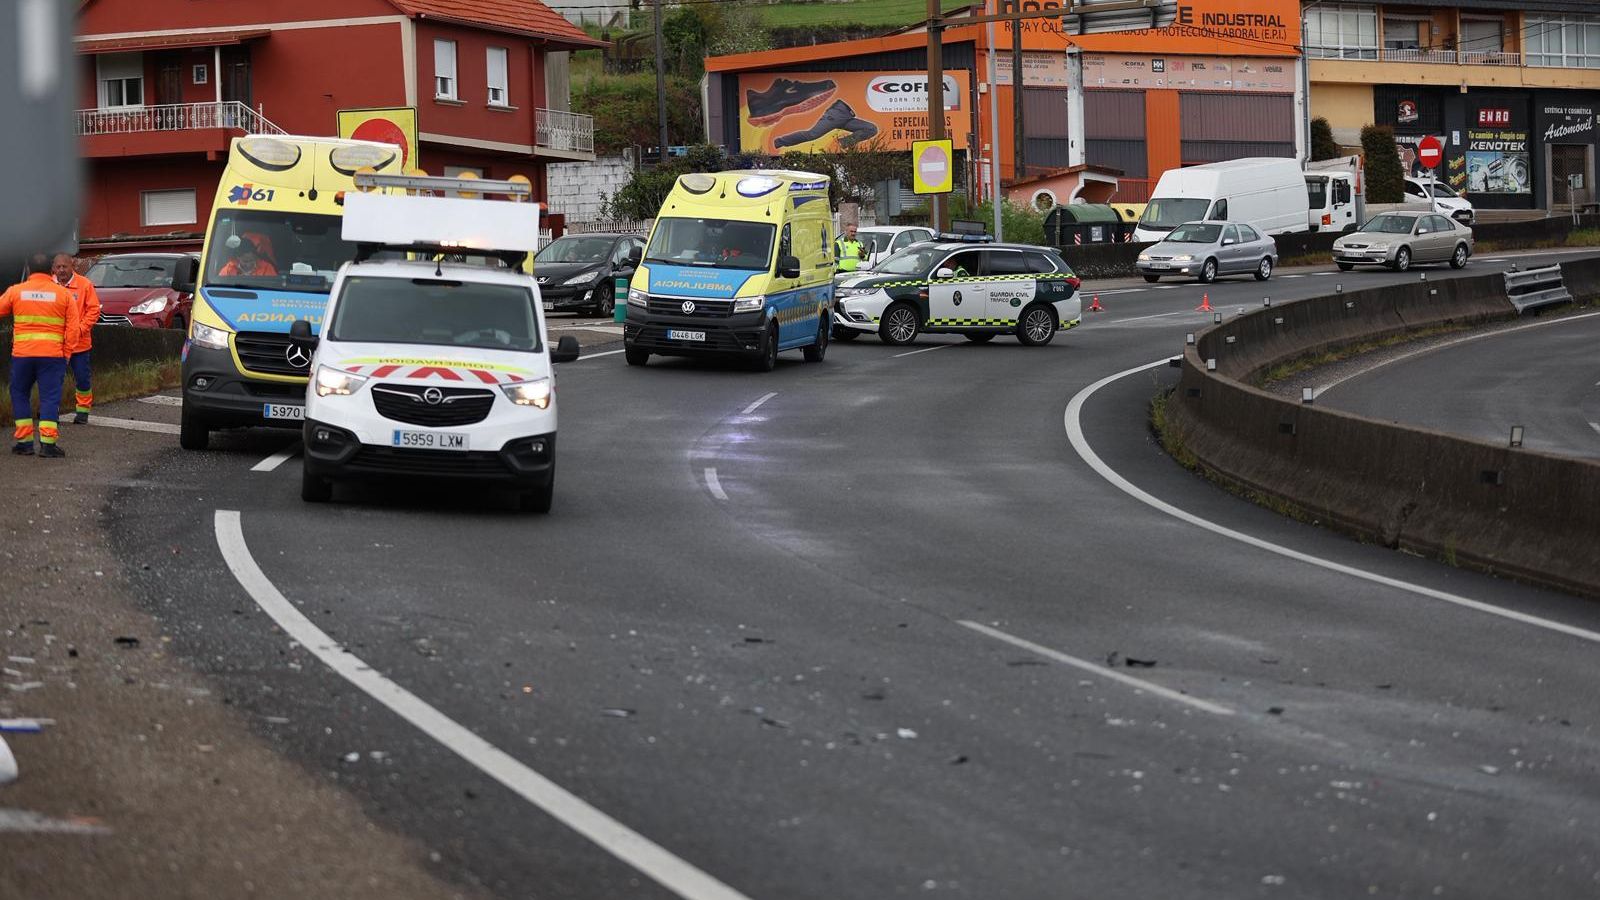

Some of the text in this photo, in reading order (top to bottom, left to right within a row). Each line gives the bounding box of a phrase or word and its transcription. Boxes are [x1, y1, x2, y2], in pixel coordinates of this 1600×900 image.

[1202, 12, 1286, 28] INDUSTRIAL
[1004, 21, 1030, 33] RPA
[1033, 21, 1040, 33] Y
[1217, 27, 1260, 39] LABORAL
[1261, 28, 1287, 41] (E.P.I.)
[1171, 61, 1185, 71] 3M
[1479, 111, 1510, 122] ENRO
[1543, 116, 1593, 141] Automóvil
[892, 130, 903, 140] EN
[1469, 141, 1526, 151] KENOTEK
[671, 331, 704, 340] 0446 LGK
[271, 406, 301, 418] 5970
[403, 432, 464, 448] 5959 LXM
